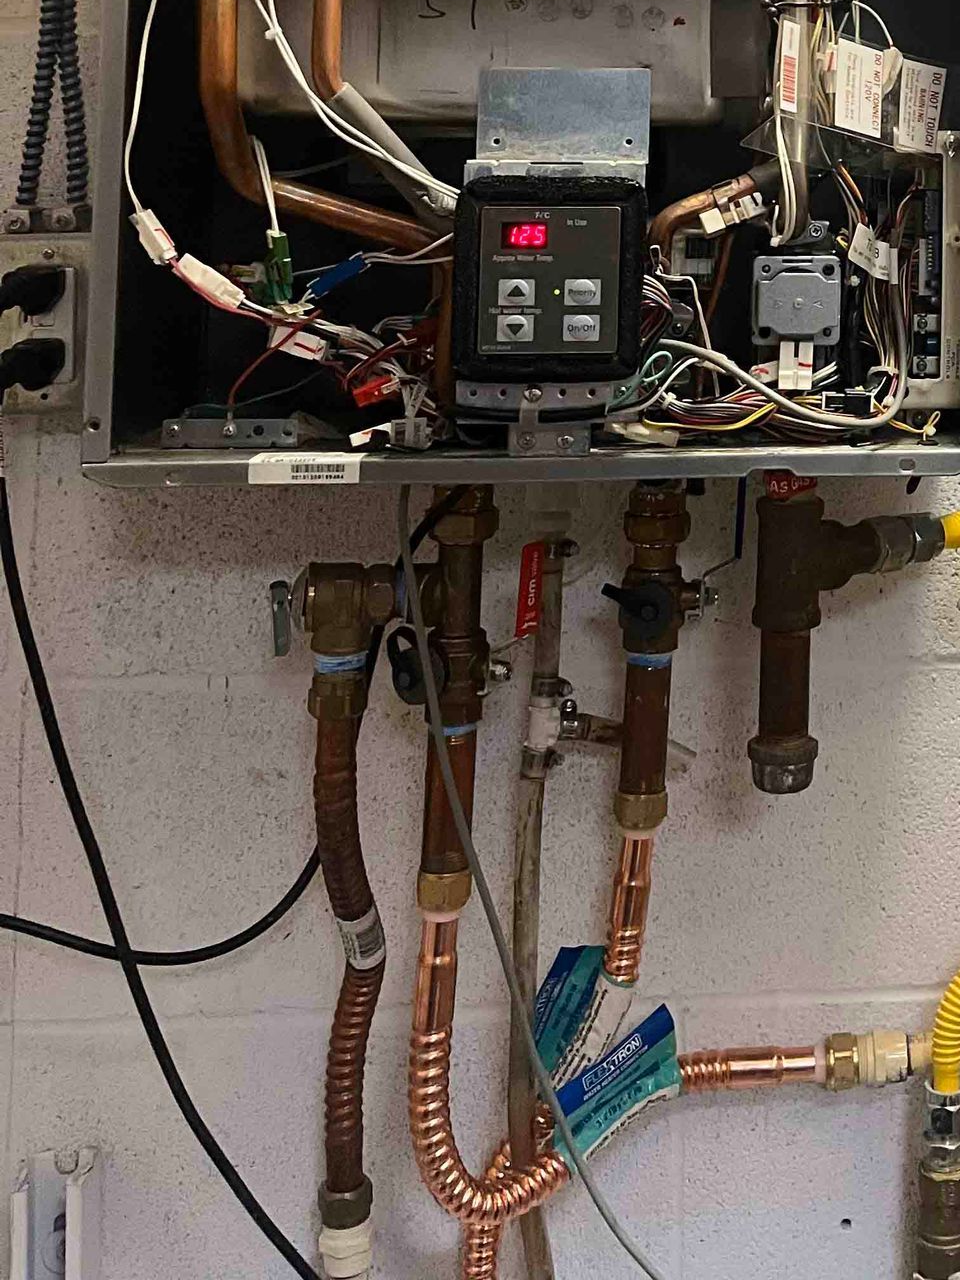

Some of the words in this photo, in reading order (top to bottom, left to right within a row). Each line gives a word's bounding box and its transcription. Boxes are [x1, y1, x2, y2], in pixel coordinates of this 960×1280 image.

[874, 53, 881, 66] DO
[932, 72, 942, 86] DO
[864, 80, 872, 102] 120V
[929, 90, 939, 109] NOT
[872, 92, 880, 132] CONNECT
[924, 117, 936, 148] TOUCH
[510, 226, 546, 245] 125
[567, 324, 596, 333] On/Off
[584, 1036, 641, 1091] FLEXTRON
